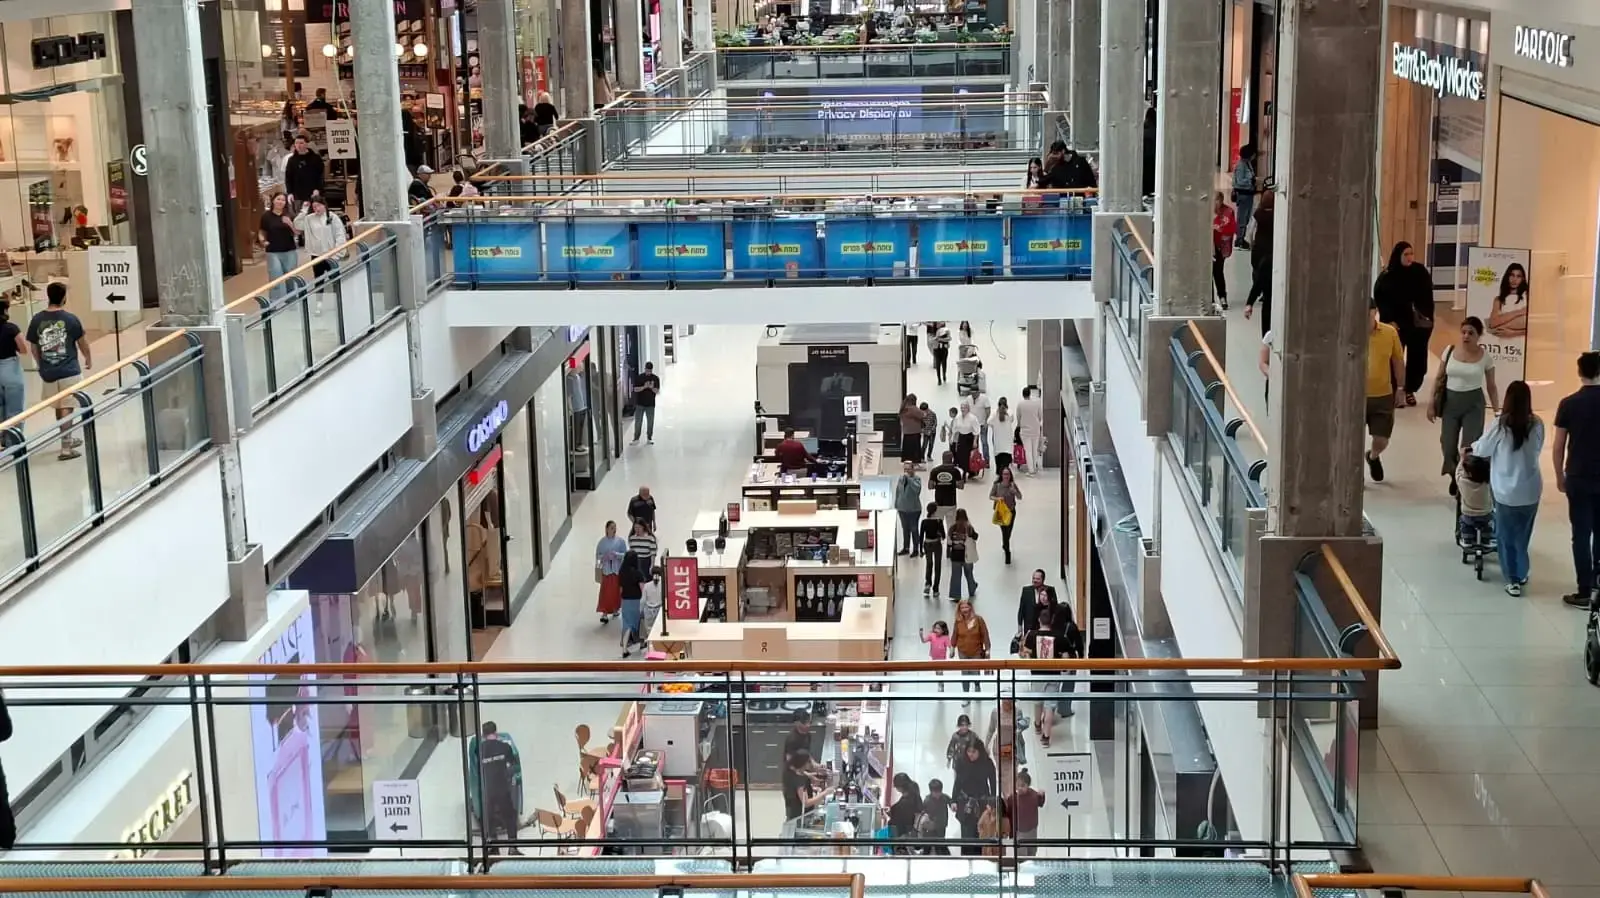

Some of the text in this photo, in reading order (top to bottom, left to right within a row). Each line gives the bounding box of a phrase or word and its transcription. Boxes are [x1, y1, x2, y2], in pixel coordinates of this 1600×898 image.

[1393, 41, 1413, 81] Bath
[1420, 50, 1446, 98] Body
[1446, 56, 1481, 101] Works
[817, 110, 857, 120] Privacy
[859, 108, 897, 120] Display
[97, 262, 130, 273] למרחב
[101, 275, 128, 288] המוגן
[674, 566, 691, 610] SALE
[1053, 769, 1084, 781] למרחב
[1056, 782, 1082, 794] המוגן
[381, 794, 411, 805] למרחב
[126, 772, 193, 858] SECRET
[384, 807, 410, 818] המוגן
